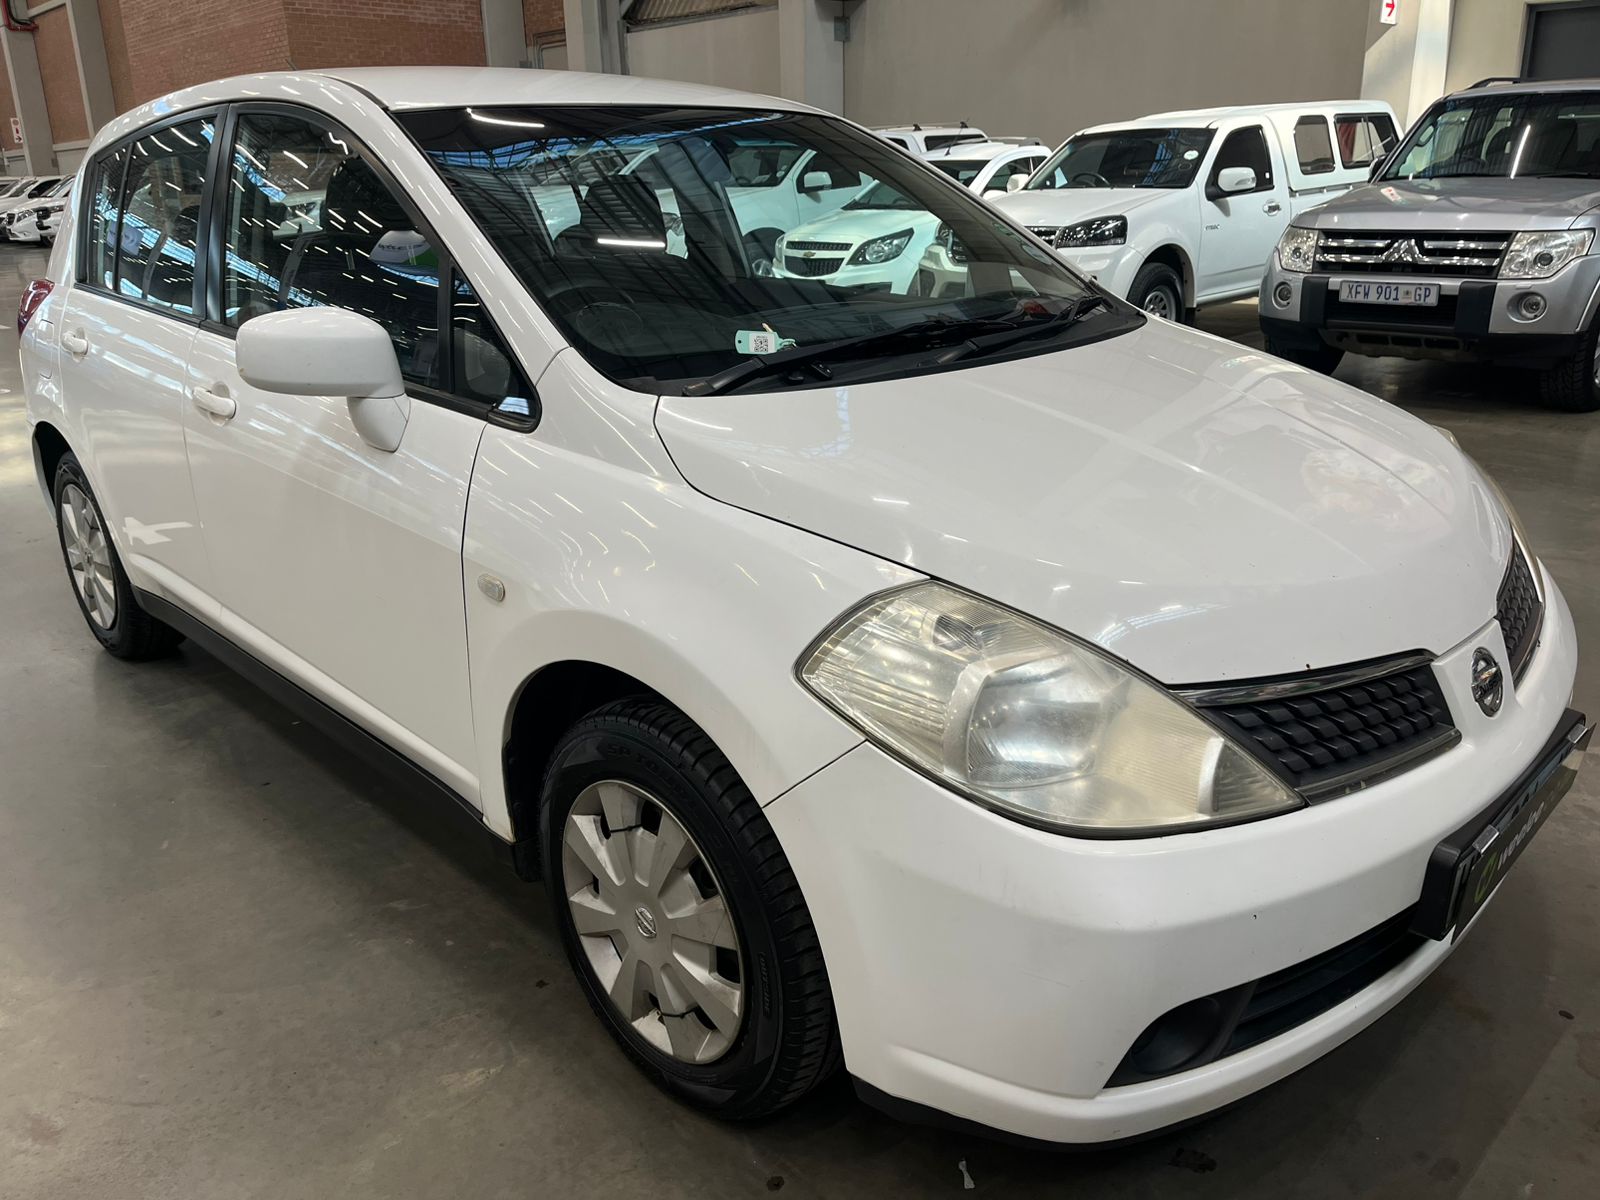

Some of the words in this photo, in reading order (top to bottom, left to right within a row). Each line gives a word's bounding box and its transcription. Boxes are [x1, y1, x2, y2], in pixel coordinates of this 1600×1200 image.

[1346, 284, 1370, 300] XFW
[1376, 285, 1400, 301] 901
[1413, 287, 1431, 302] GP
